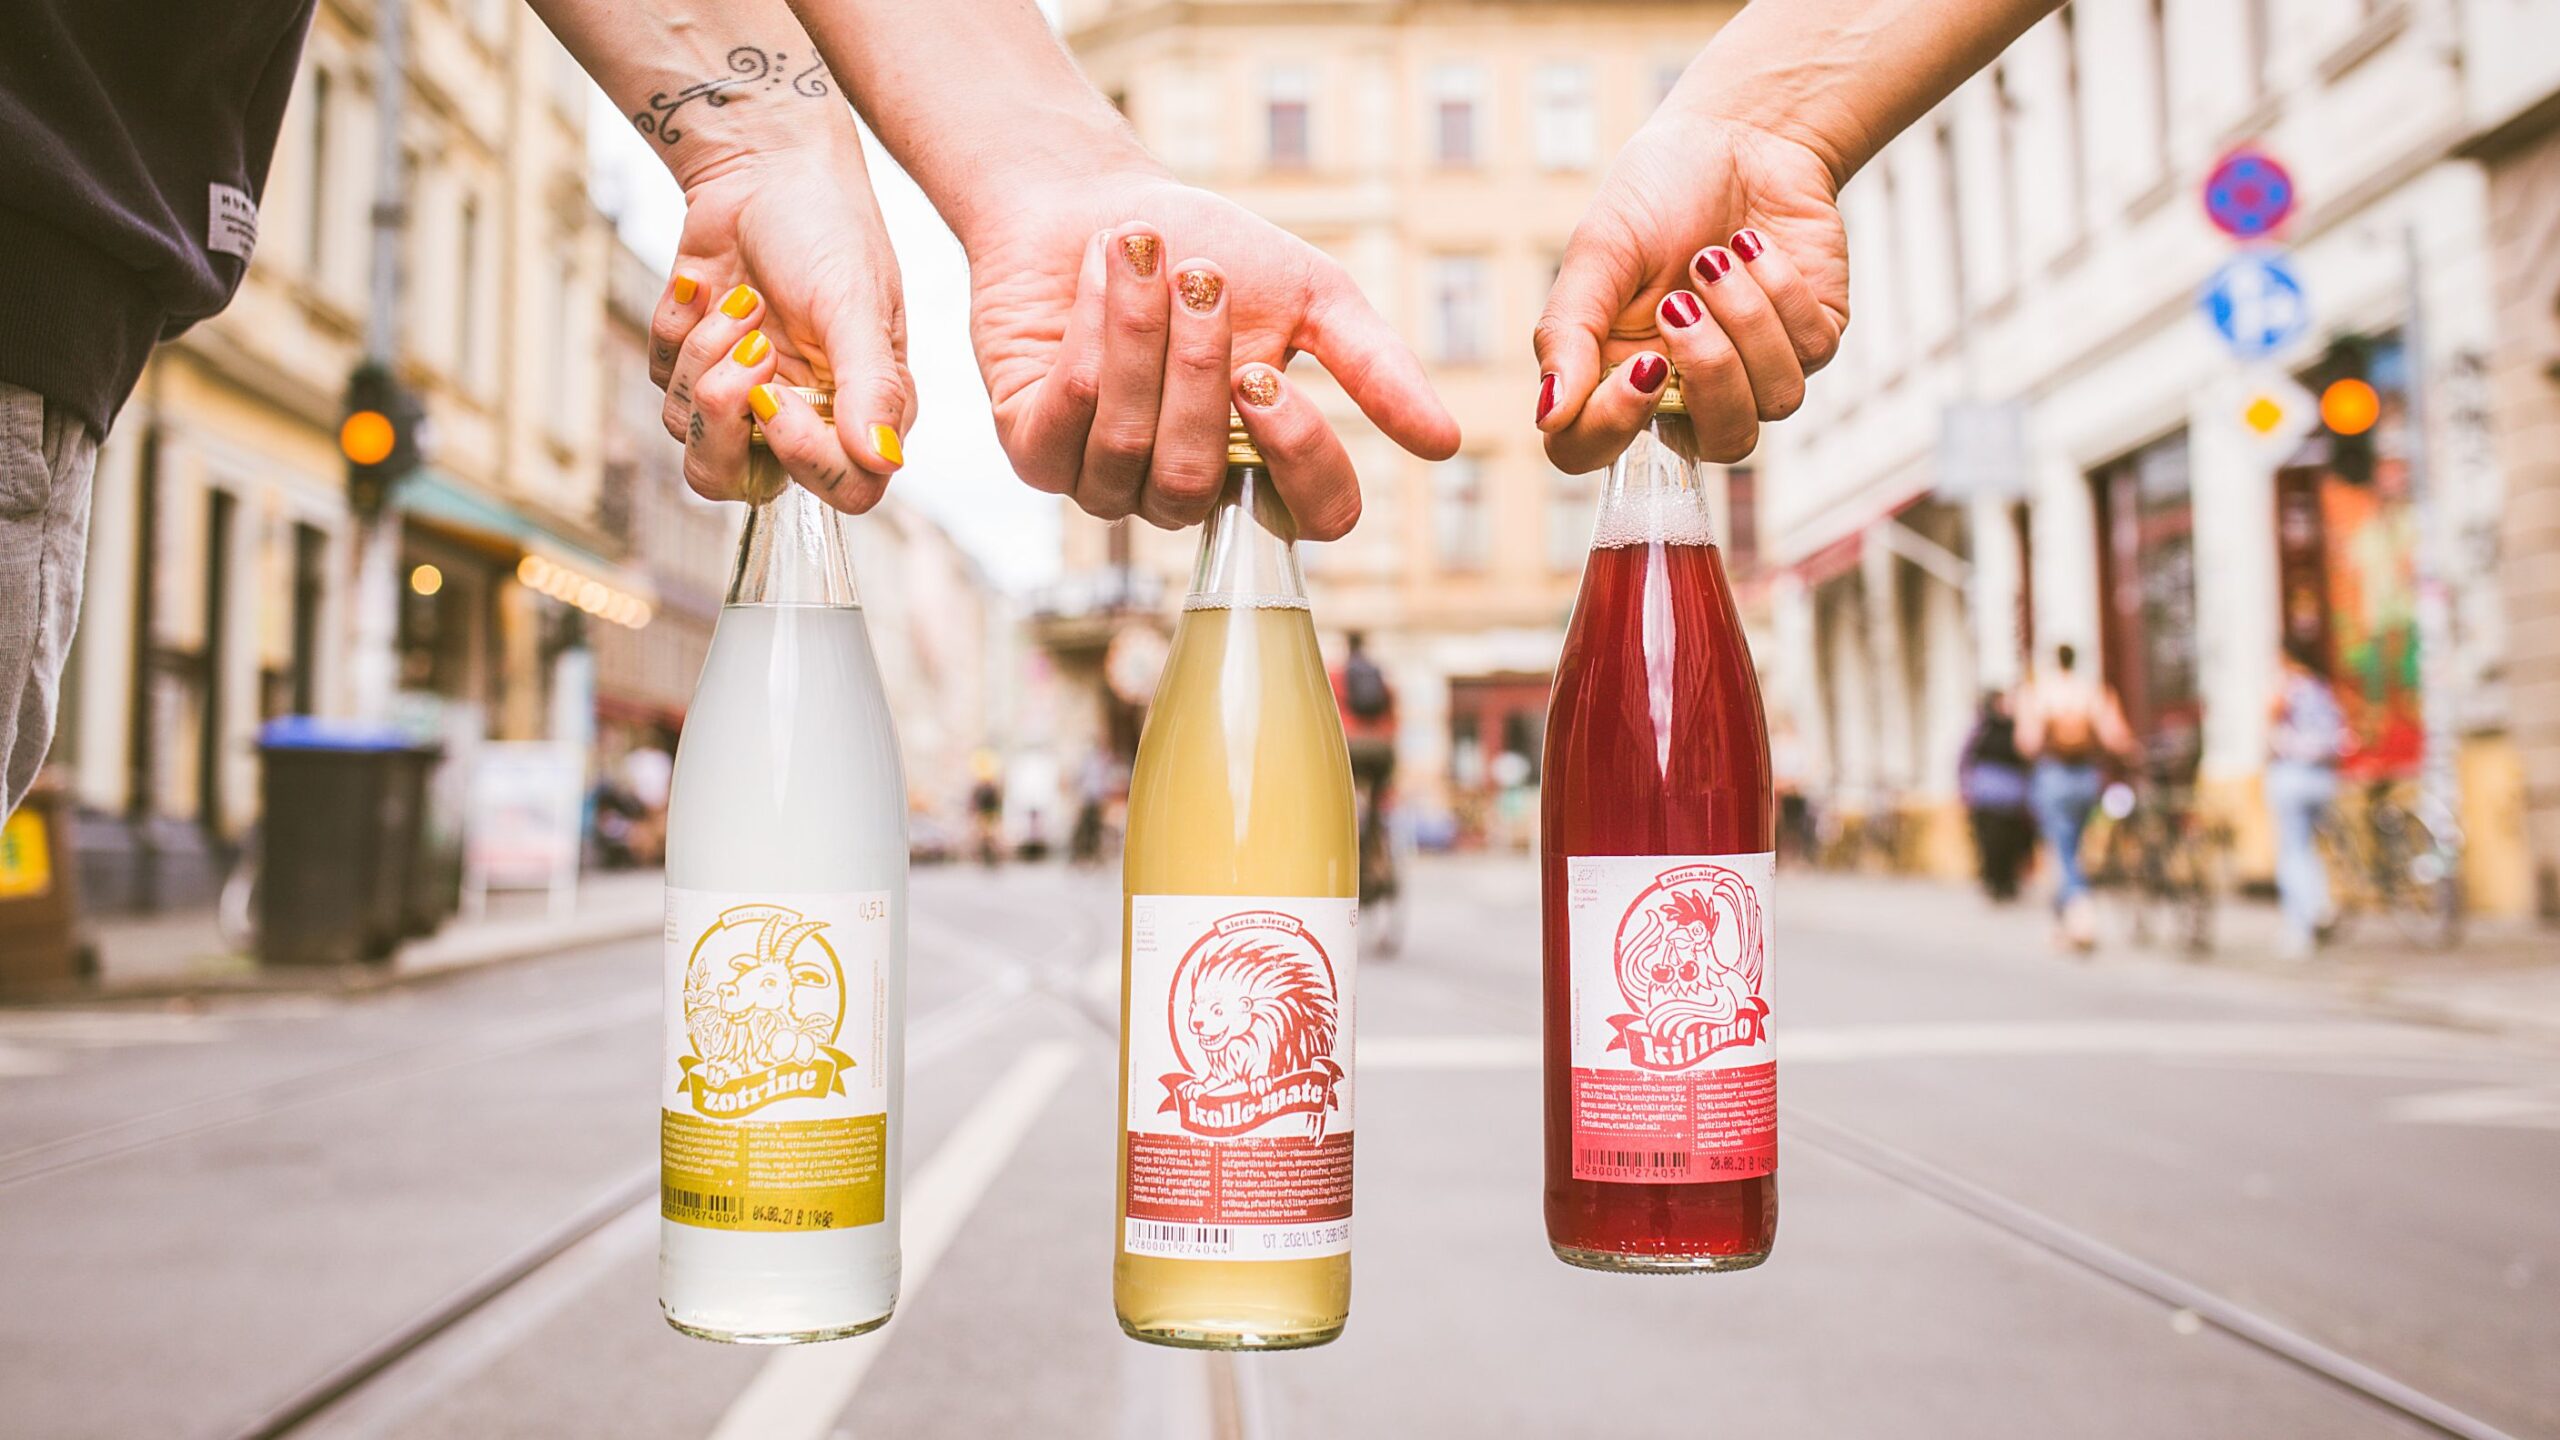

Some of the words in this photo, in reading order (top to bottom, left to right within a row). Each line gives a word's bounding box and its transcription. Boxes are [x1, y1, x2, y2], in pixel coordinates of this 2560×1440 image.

[1641, 1018, 1752, 1066] kilimo
[702, 1069, 817, 1111] zotrine
[1188, 1078, 1323, 1129] kolle-mate
[1585, 1167, 1628, 1177] 280001
[1635, 1168, 1684, 1178] 274051
[695, 1210, 738, 1224] 274006
[1135, 1240, 1172, 1250] 280001
[1178, 1243, 1227, 1254] 274044
